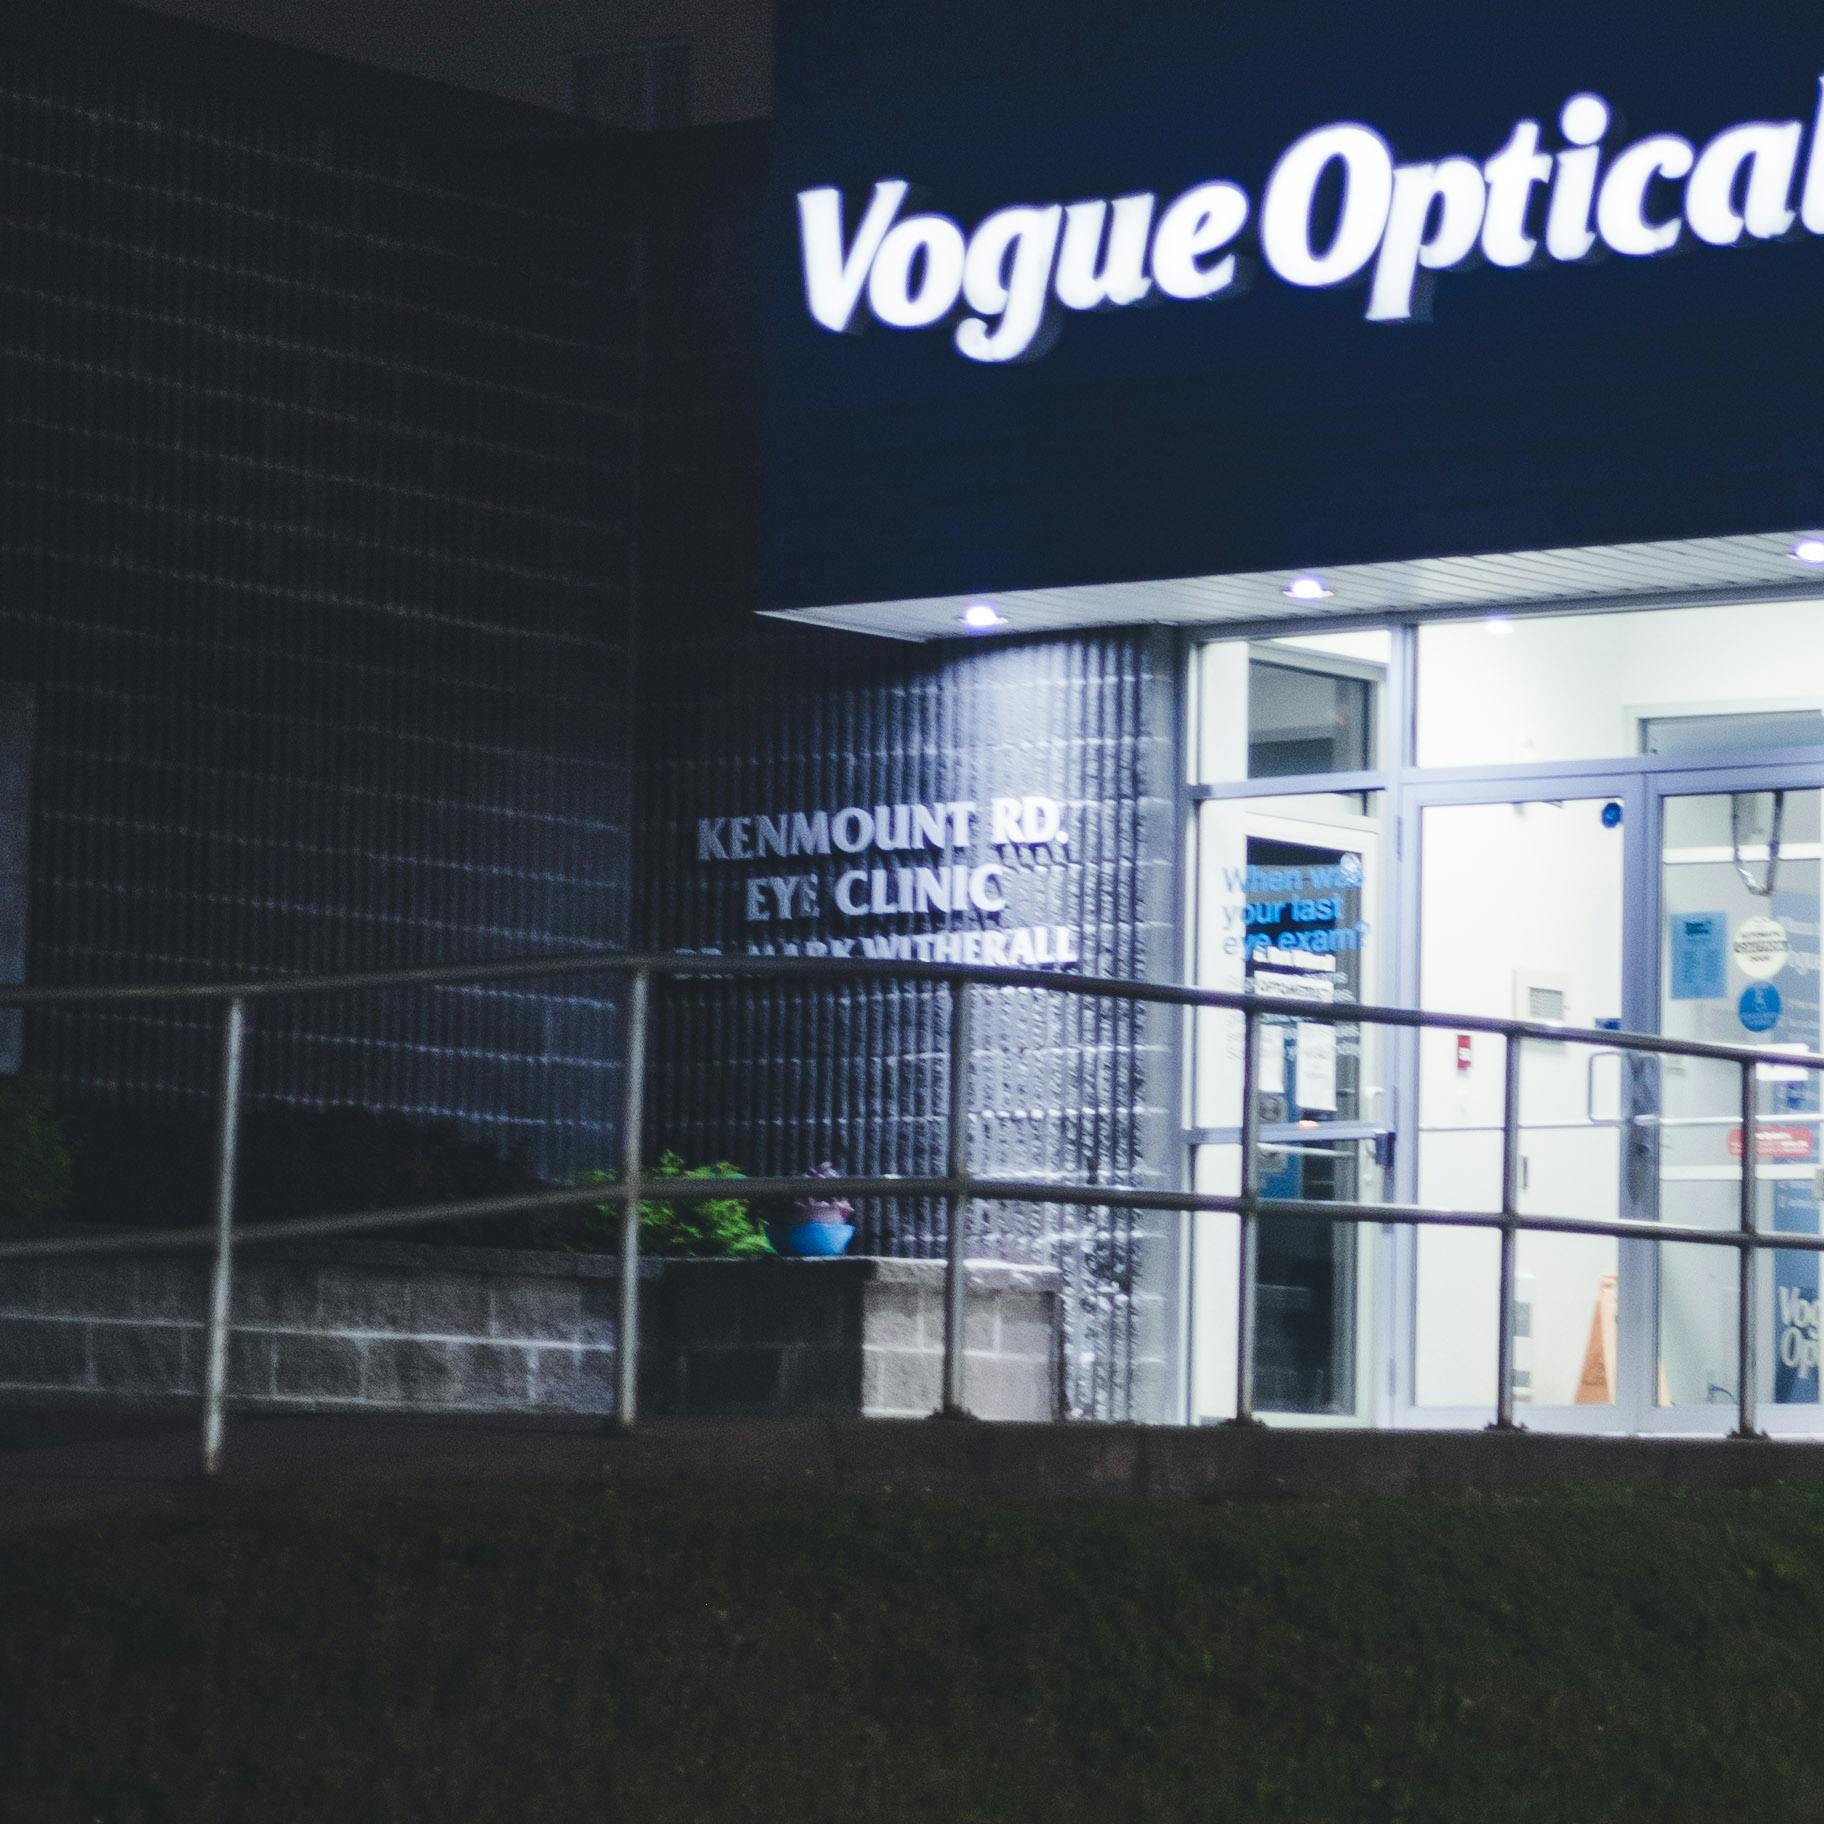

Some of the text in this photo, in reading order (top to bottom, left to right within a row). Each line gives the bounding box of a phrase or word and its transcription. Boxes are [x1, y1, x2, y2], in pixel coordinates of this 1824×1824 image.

[798, 179, 1249, 363] Vogue
[699, 796, 1070, 862] KENMOUNT RD.
[746, 863, 1007, 922] EYE CLINIC
[1291, 893, 1344, 922] last
